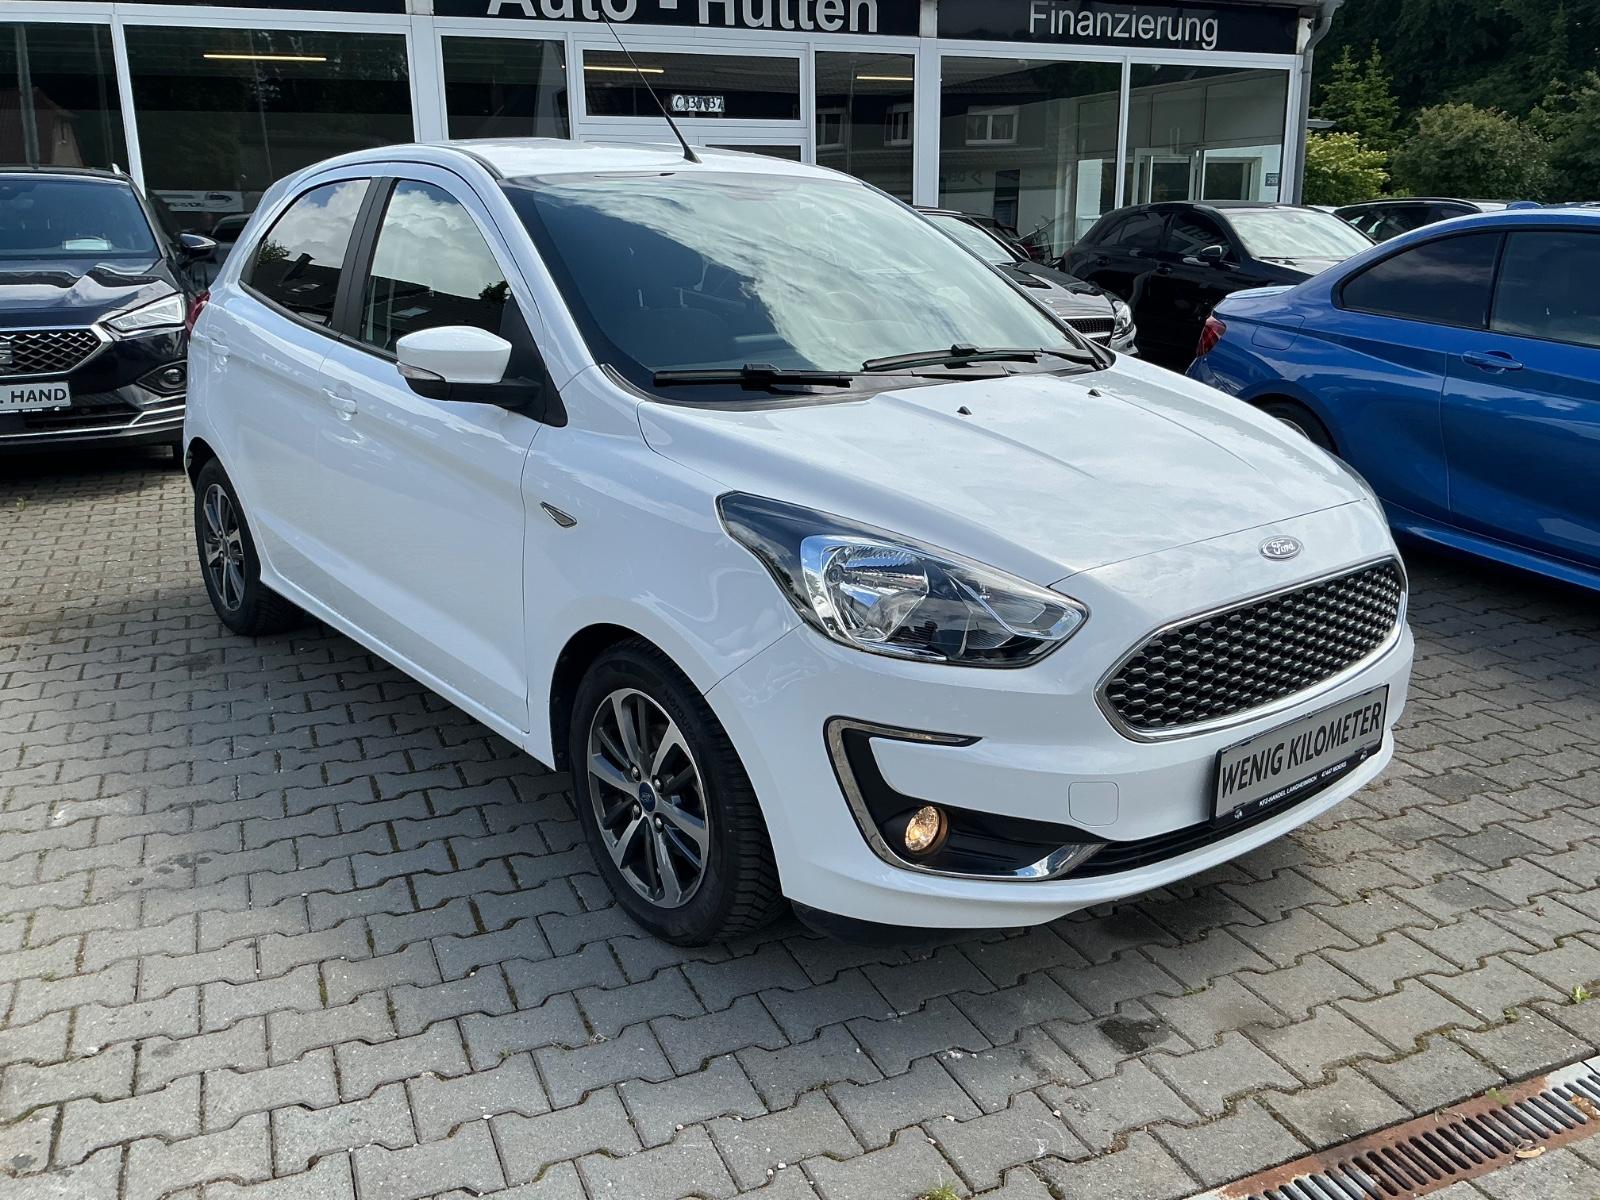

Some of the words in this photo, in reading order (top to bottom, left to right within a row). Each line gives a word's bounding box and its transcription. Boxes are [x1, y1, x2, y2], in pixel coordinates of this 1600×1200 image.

[1028, 1, 1219, 50] Finanzierung
[10, 388, 67, 403] HAND
[1271, 540, 1296, 554] Ford
[1222, 742, 1285, 798] WENIG
[1287, 702, 1382, 770] KILOMETER
